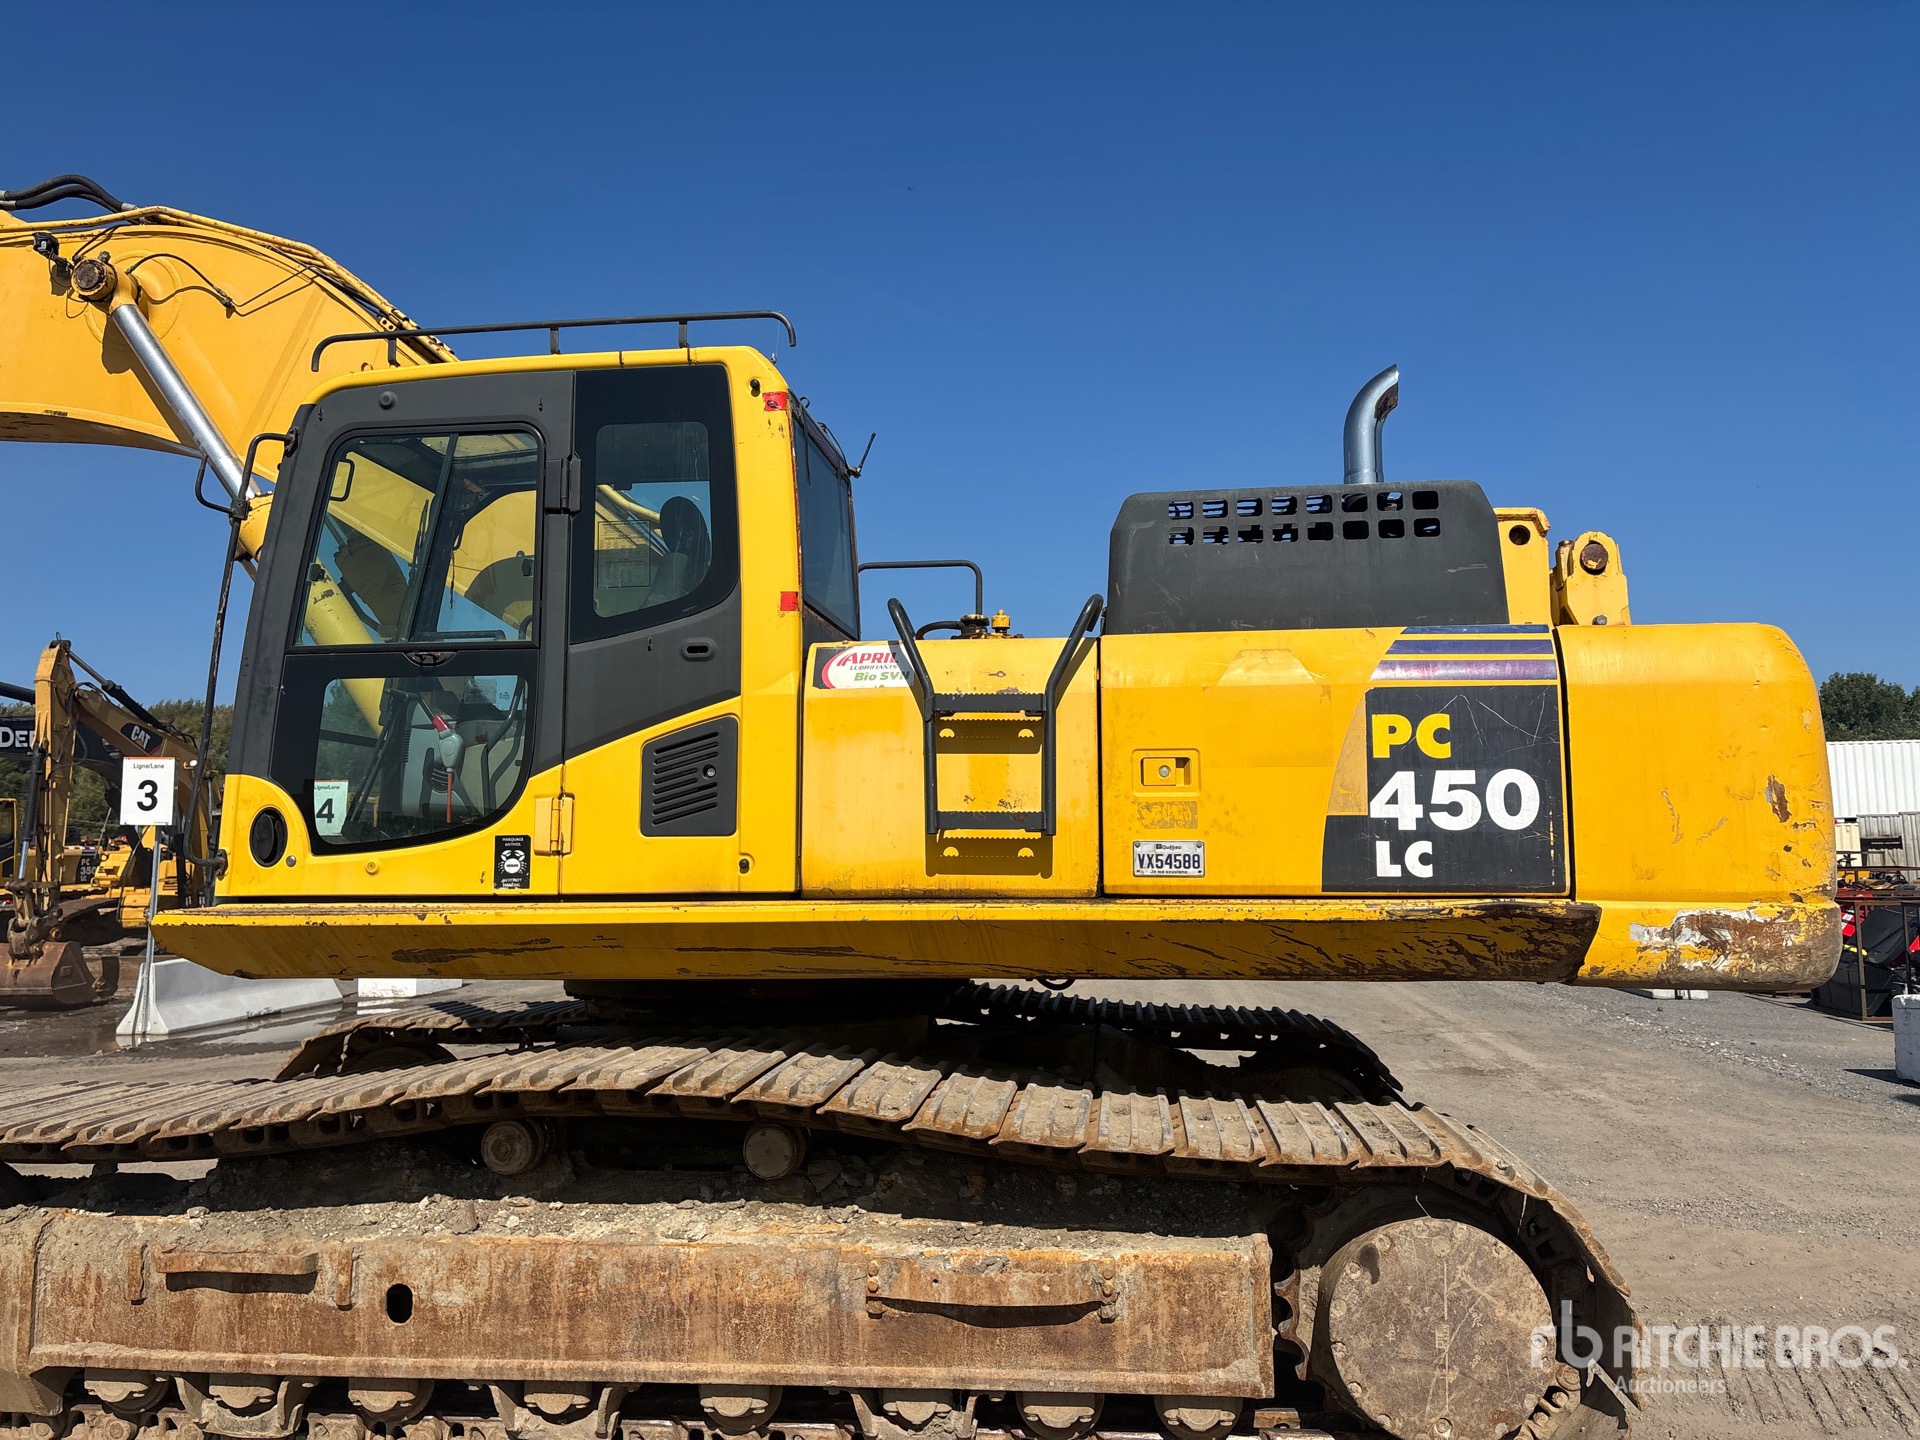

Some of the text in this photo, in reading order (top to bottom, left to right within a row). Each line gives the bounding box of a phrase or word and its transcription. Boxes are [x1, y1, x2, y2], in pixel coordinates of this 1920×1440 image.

[836, 652, 898, 666] APRIL
[854, 672, 877, 681] Bio
[131, 725, 151, 750] CAT
[1371, 713, 1452, 759] PC
[136, 779, 158, 812] 3
[1370, 768, 1540, 831] 450
[316, 798, 335, 824] 4
[1137, 853, 1201, 870] VX54588
[1375, 840, 1434, 878] LC
